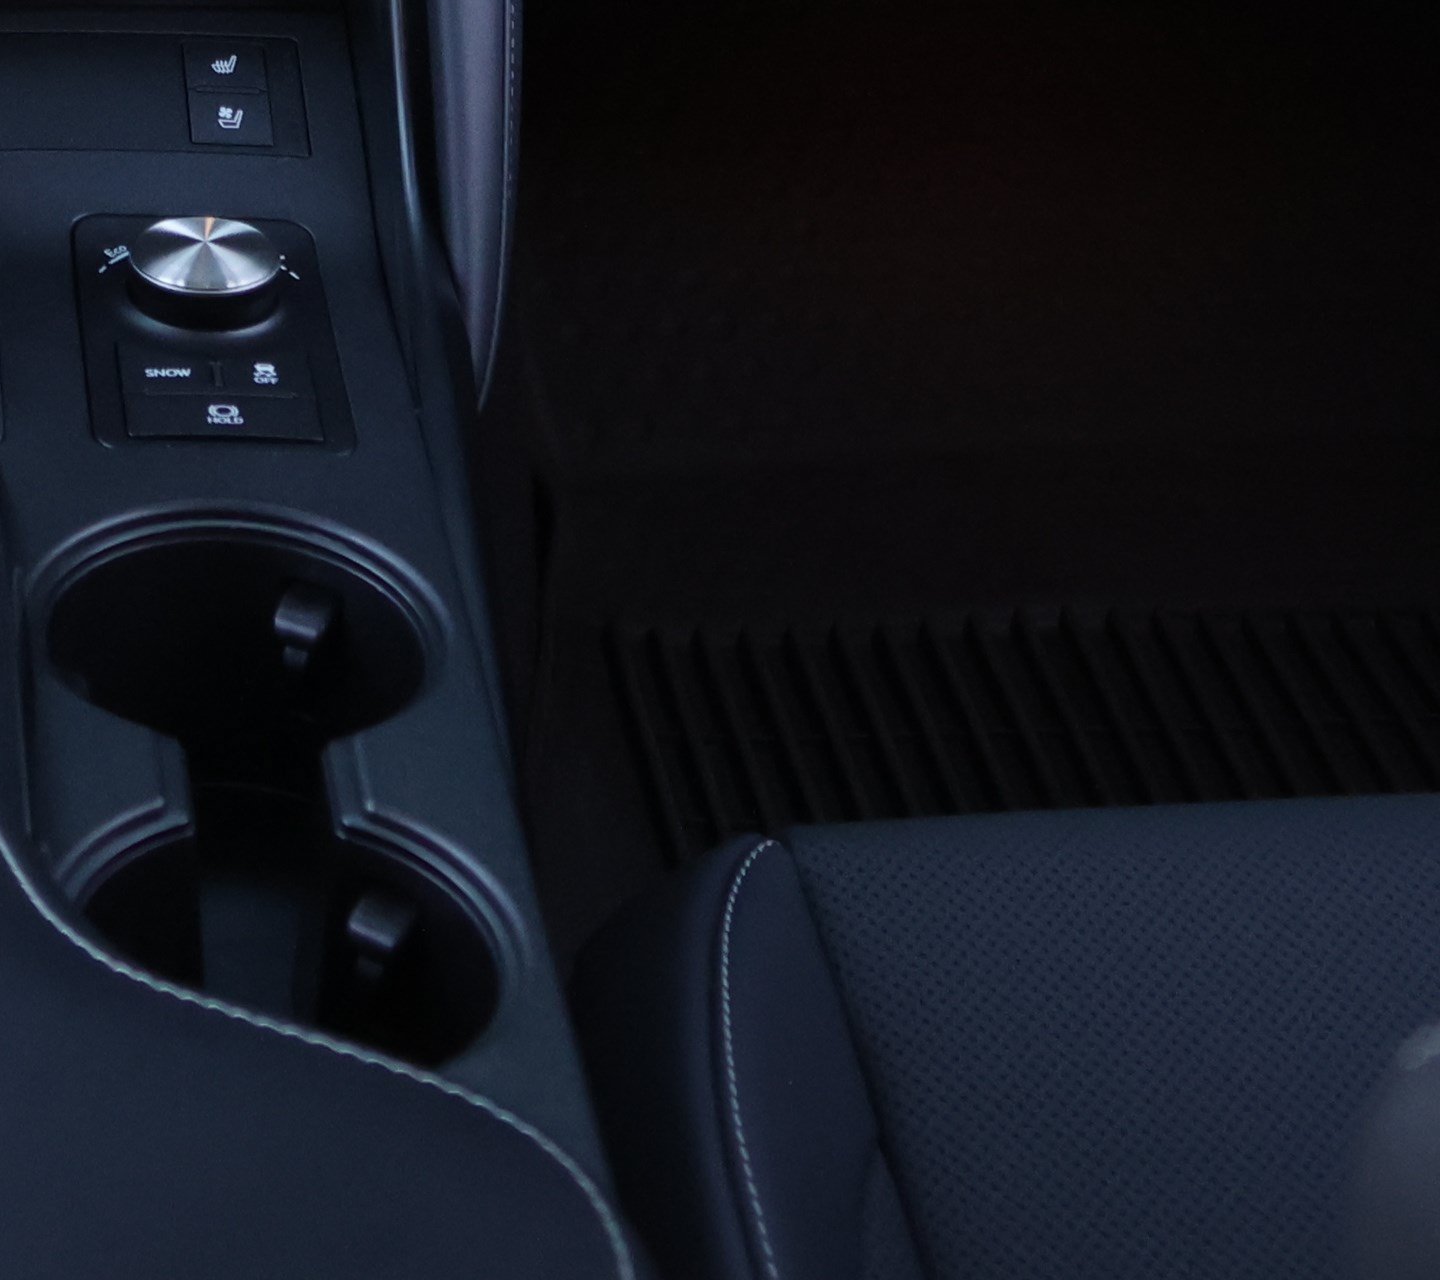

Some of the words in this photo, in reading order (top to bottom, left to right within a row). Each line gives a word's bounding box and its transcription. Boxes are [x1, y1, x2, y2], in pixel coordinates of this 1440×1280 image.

[104, 245, 128, 259] Eco
[144, 367, 192, 378] SNOW
[253, 376, 279, 385] OFF
[207, 415, 244, 425] HOLD
